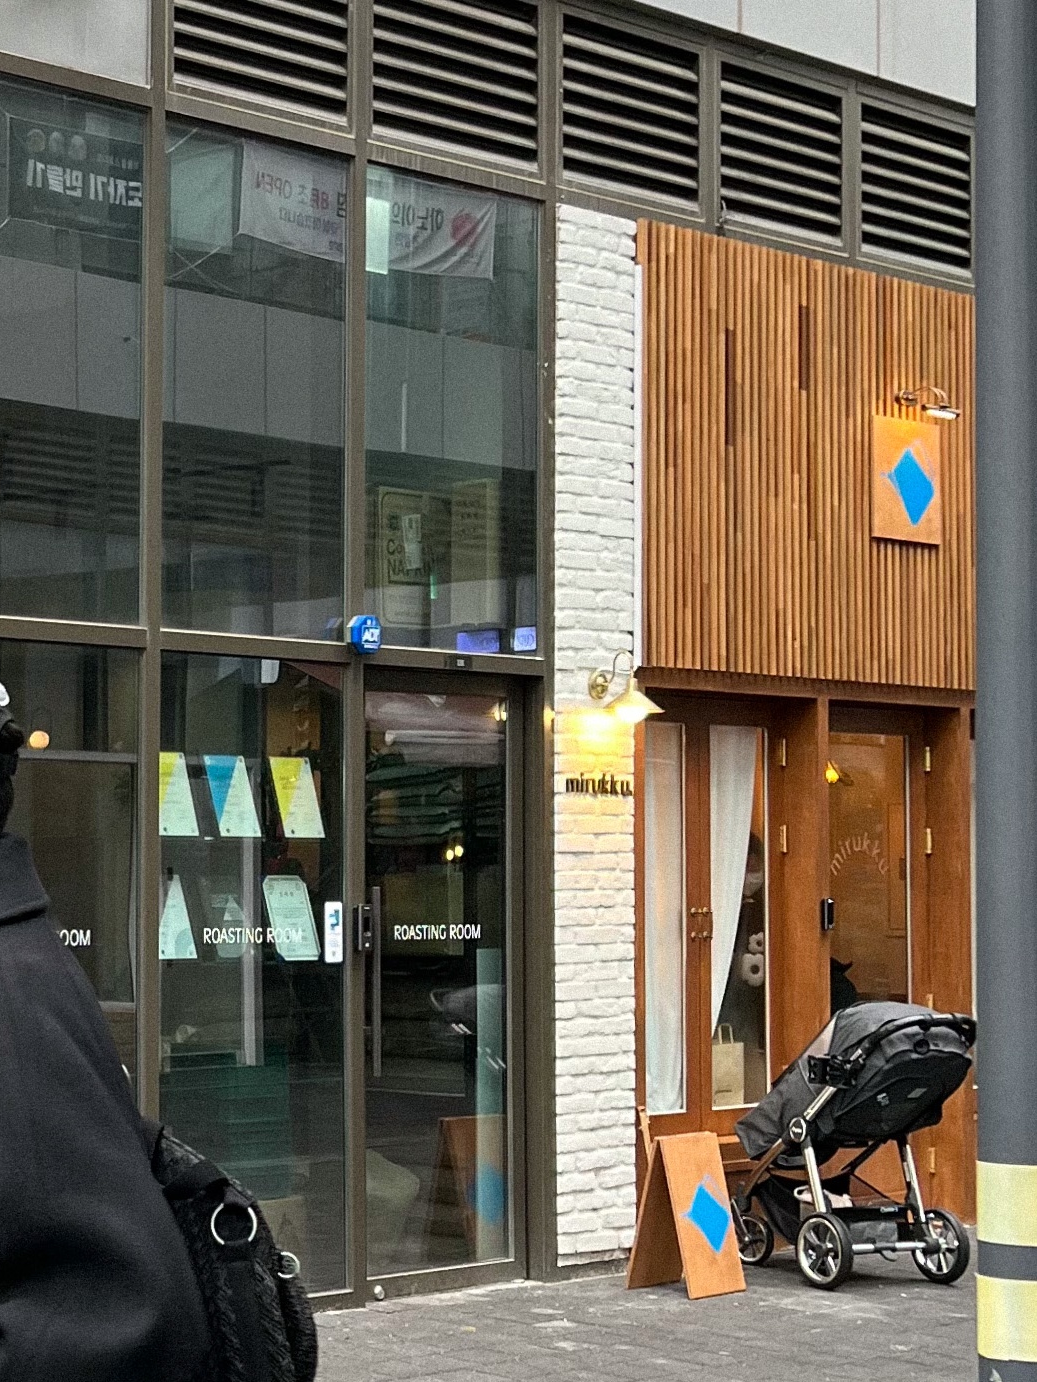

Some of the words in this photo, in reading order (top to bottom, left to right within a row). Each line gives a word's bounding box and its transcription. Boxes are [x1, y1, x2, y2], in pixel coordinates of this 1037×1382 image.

[830, 832, 890, 876] mirukku
[56, 927, 91, 946] OOM
[203, 927, 263, 944] ROASTING
[266, 926, 303, 944] ROOM
[394, 924, 447, 940] ROASTING
[449, 923, 481, 940] ROOM
